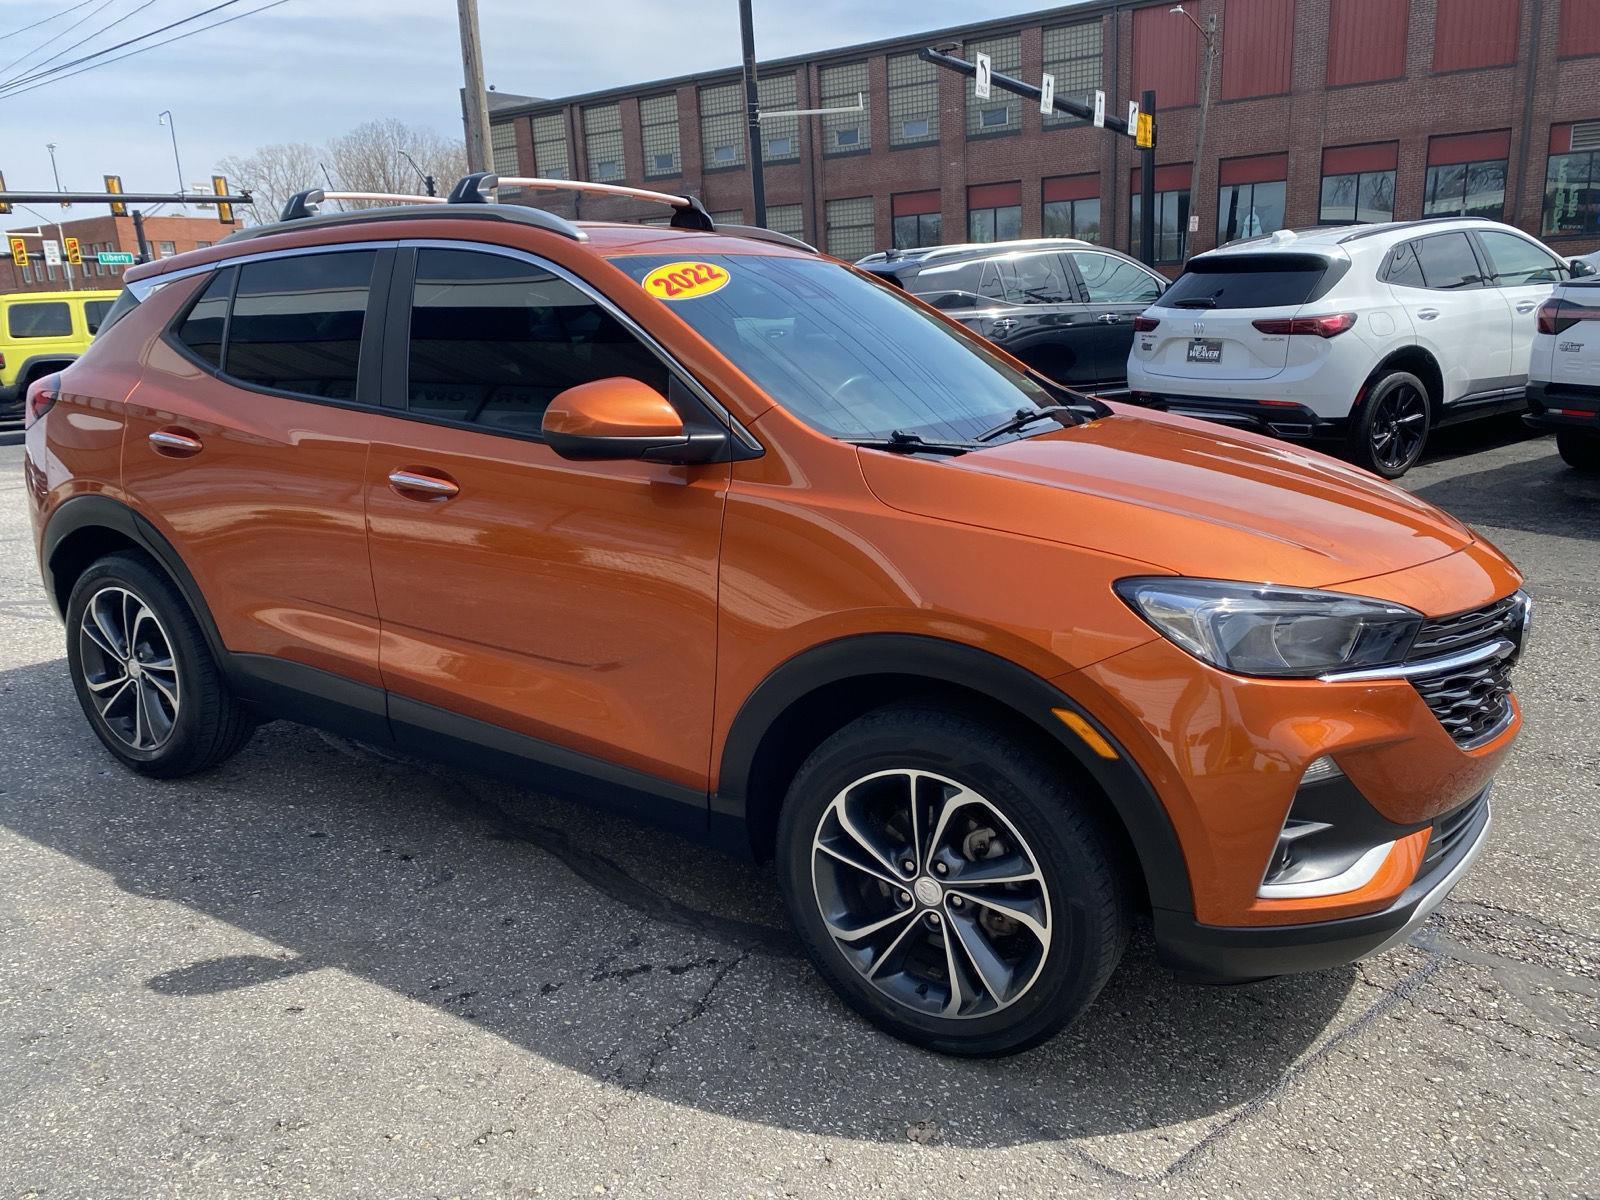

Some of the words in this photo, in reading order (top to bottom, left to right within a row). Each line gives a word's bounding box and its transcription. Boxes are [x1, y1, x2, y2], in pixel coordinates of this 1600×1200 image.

[101, 254, 130, 263] Liberty
[653, 264, 724, 297] 2022
[1189, 350, 1220, 358] WEAVER
